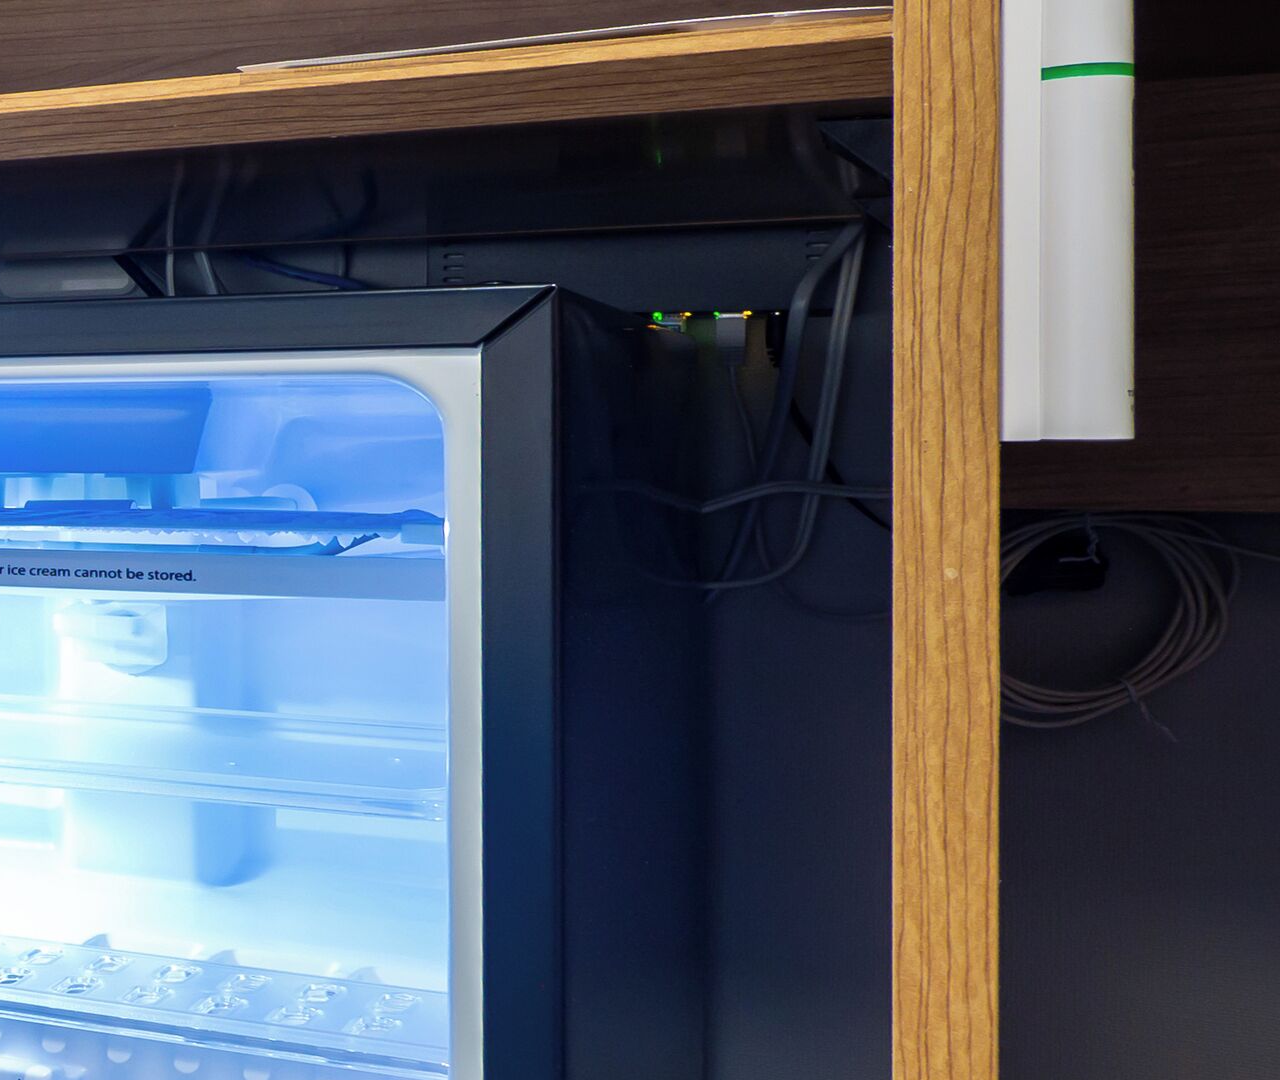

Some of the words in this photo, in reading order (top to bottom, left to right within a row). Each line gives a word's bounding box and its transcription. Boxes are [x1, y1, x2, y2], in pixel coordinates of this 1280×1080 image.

[7, 564, 26, 576] ice
[29, 567, 71, 578] cream
[74, 568, 122, 580] cannot
[126, 568, 144, 580] be
[148, 569, 197, 582] stored.
